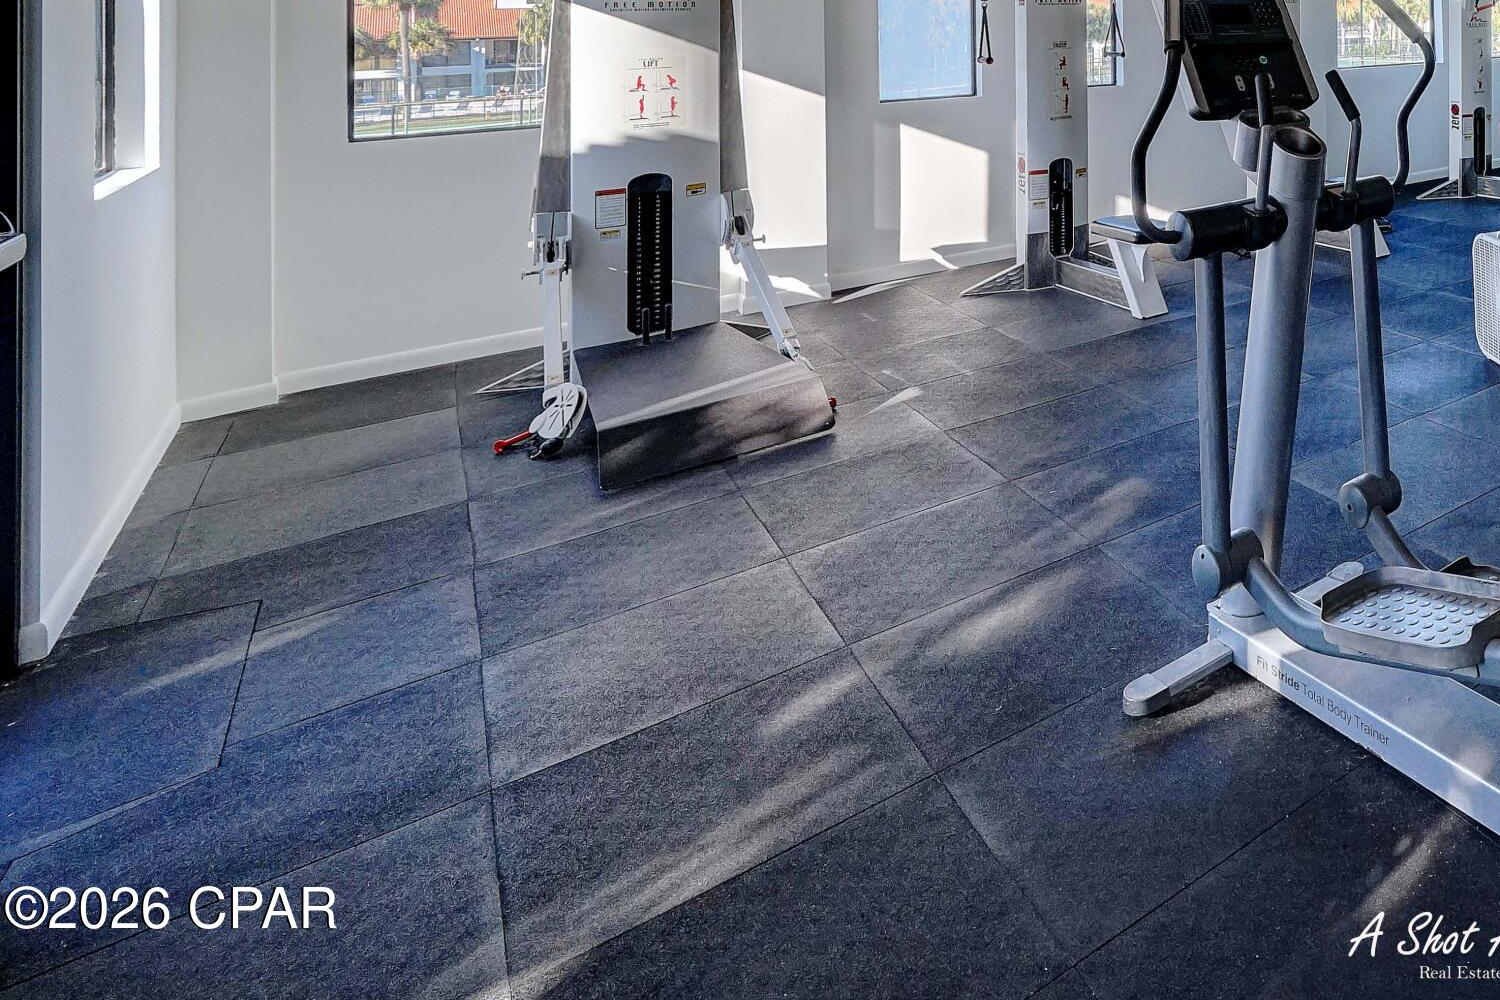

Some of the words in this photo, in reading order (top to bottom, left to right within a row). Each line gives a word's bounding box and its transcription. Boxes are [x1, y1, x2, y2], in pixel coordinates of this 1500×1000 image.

[604, 1, 637, 9] FREE
[1256, 655, 1269, 672] Fit
[1271, 664, 1301, 692] Stride
[1301, 682, 1326, 707] Total
[1327, 698, 1352, 726] Body
[1354, 714, 1390, 747] Trainer
